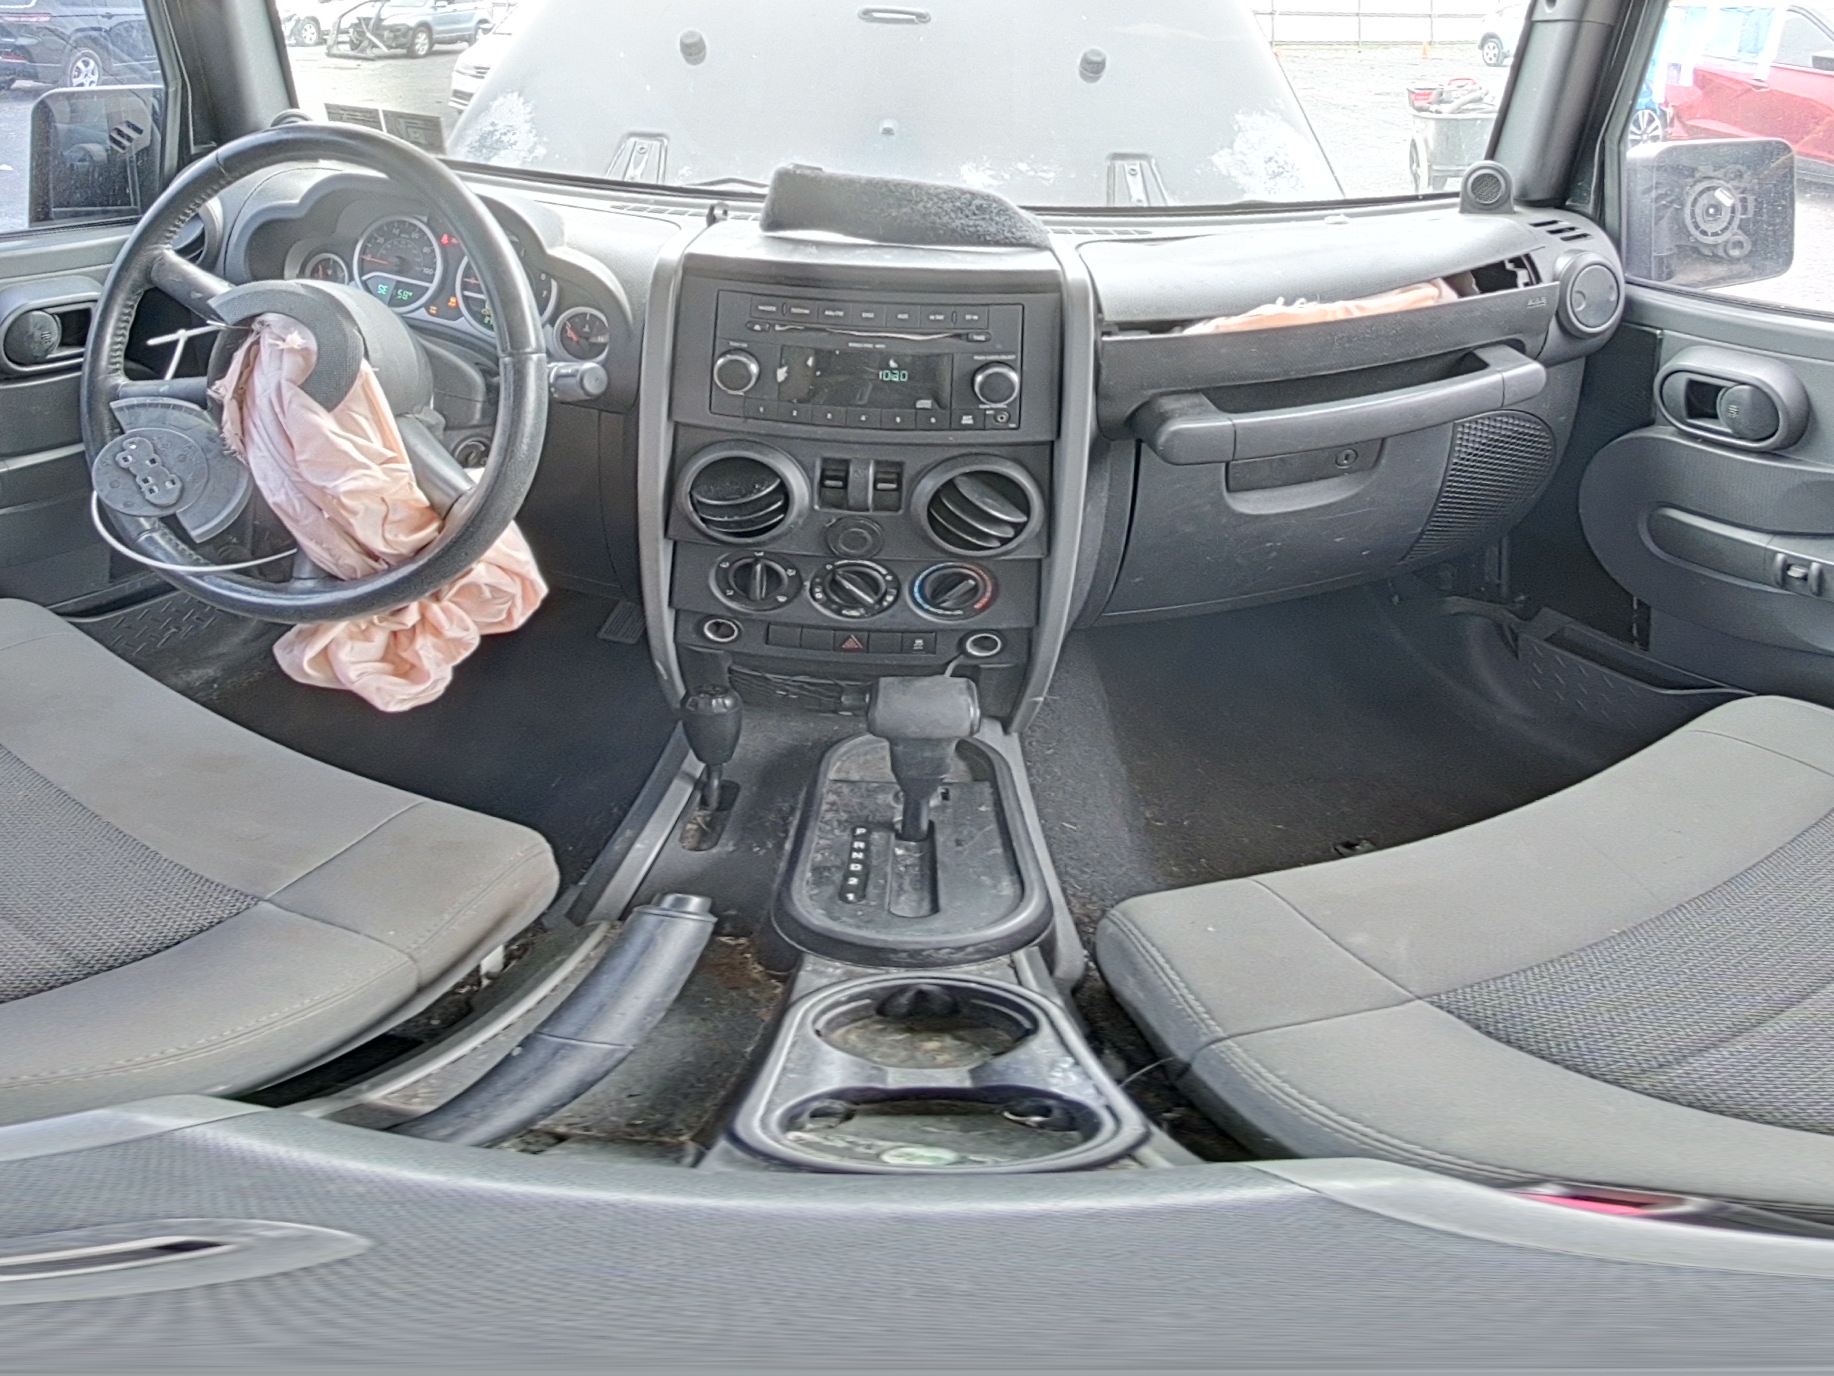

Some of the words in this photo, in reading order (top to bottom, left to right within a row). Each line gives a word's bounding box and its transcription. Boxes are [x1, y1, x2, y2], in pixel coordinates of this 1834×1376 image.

[854, 827, 867, 836] P
[849, 863, 862, 871] D
[847, 877, 859, 885] 2
[846, 893, 855, 901] 1
